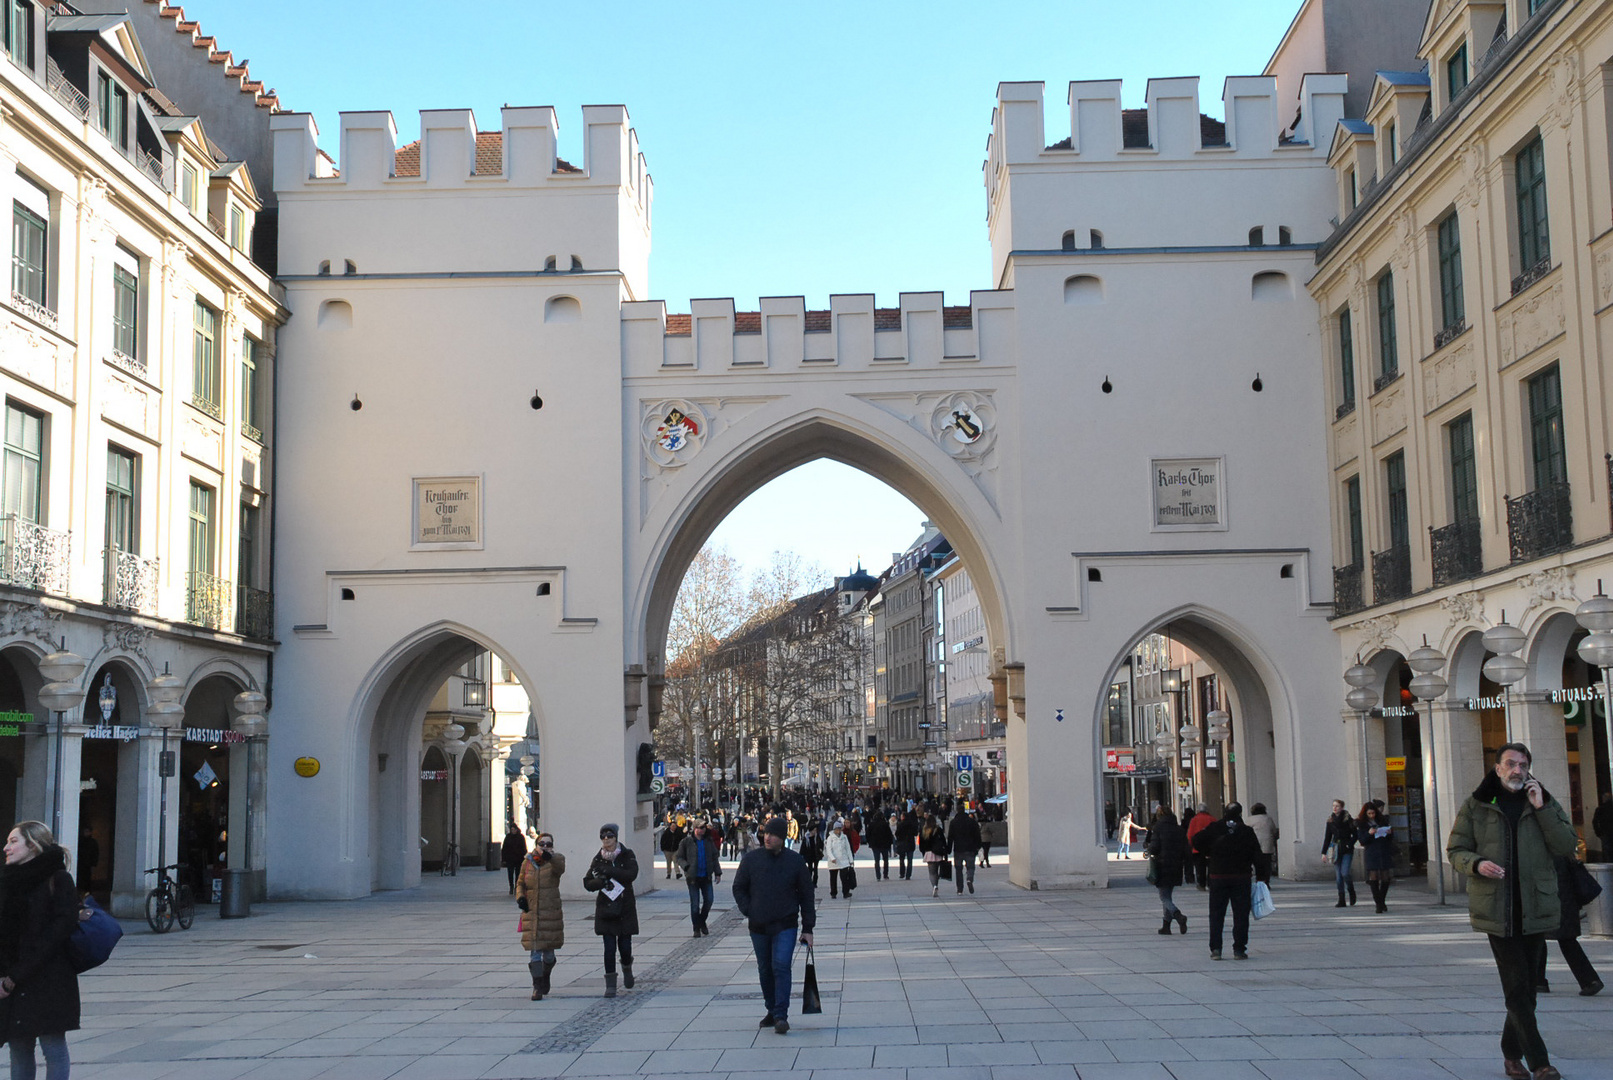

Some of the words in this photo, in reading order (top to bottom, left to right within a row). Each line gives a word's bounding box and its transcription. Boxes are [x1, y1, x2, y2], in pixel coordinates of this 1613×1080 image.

[1158, 468, 1187, 487] Karls
[1188, 468, 1215, 487] Thor
[435, 502, 458, 516] Thor
[1179, 502, 1200, 517] Mai
[1200, 504, 1216, 516] 1791
[113, 725, 139, 742] Hager
[186, 727, 223, 743] KARSTADT
[651, 761, 661, 776] U
[959, 756, 969, 770] U
[651, 780, 662, 792] S
[960, 774, 970, 785] S
